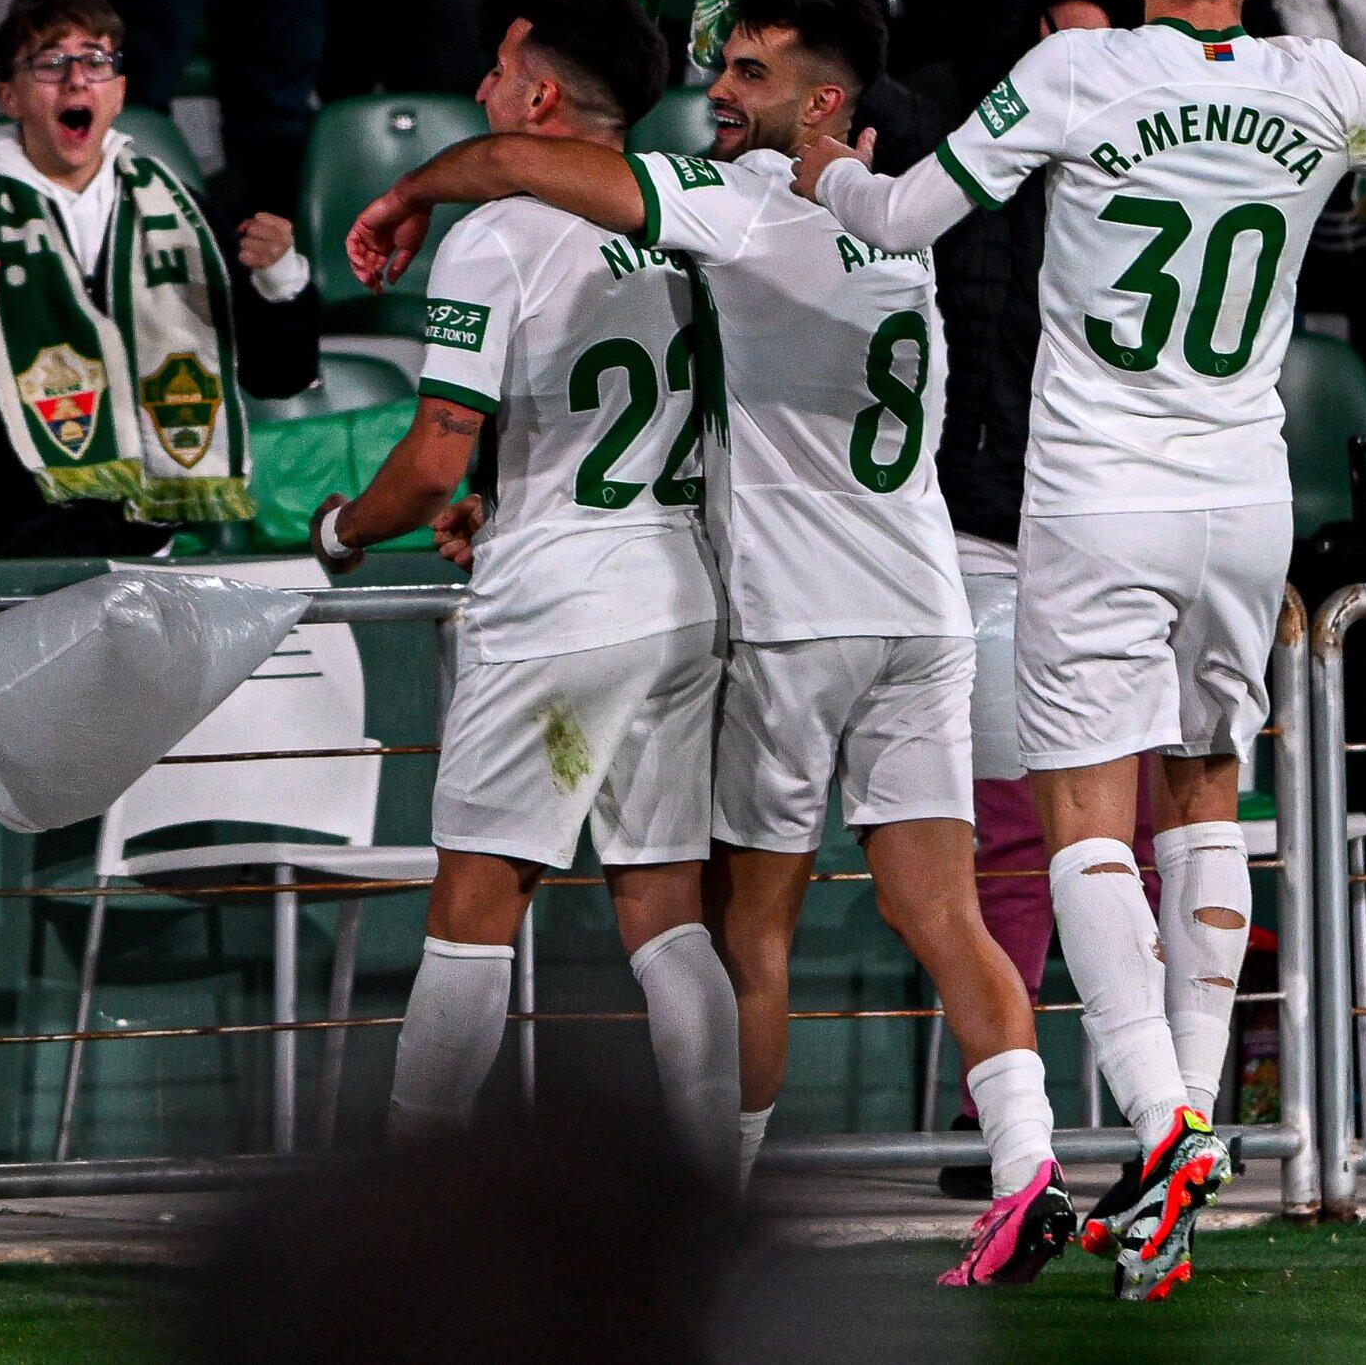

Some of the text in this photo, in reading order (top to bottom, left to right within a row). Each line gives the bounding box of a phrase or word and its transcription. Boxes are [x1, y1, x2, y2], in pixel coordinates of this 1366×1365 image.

[1089, 102, 1324, 186] R.MENDOZA
[1084, 194, 1287, 373] 30
[568, 322, 706, 511] 22
[849, 309, 929, 494] 8
